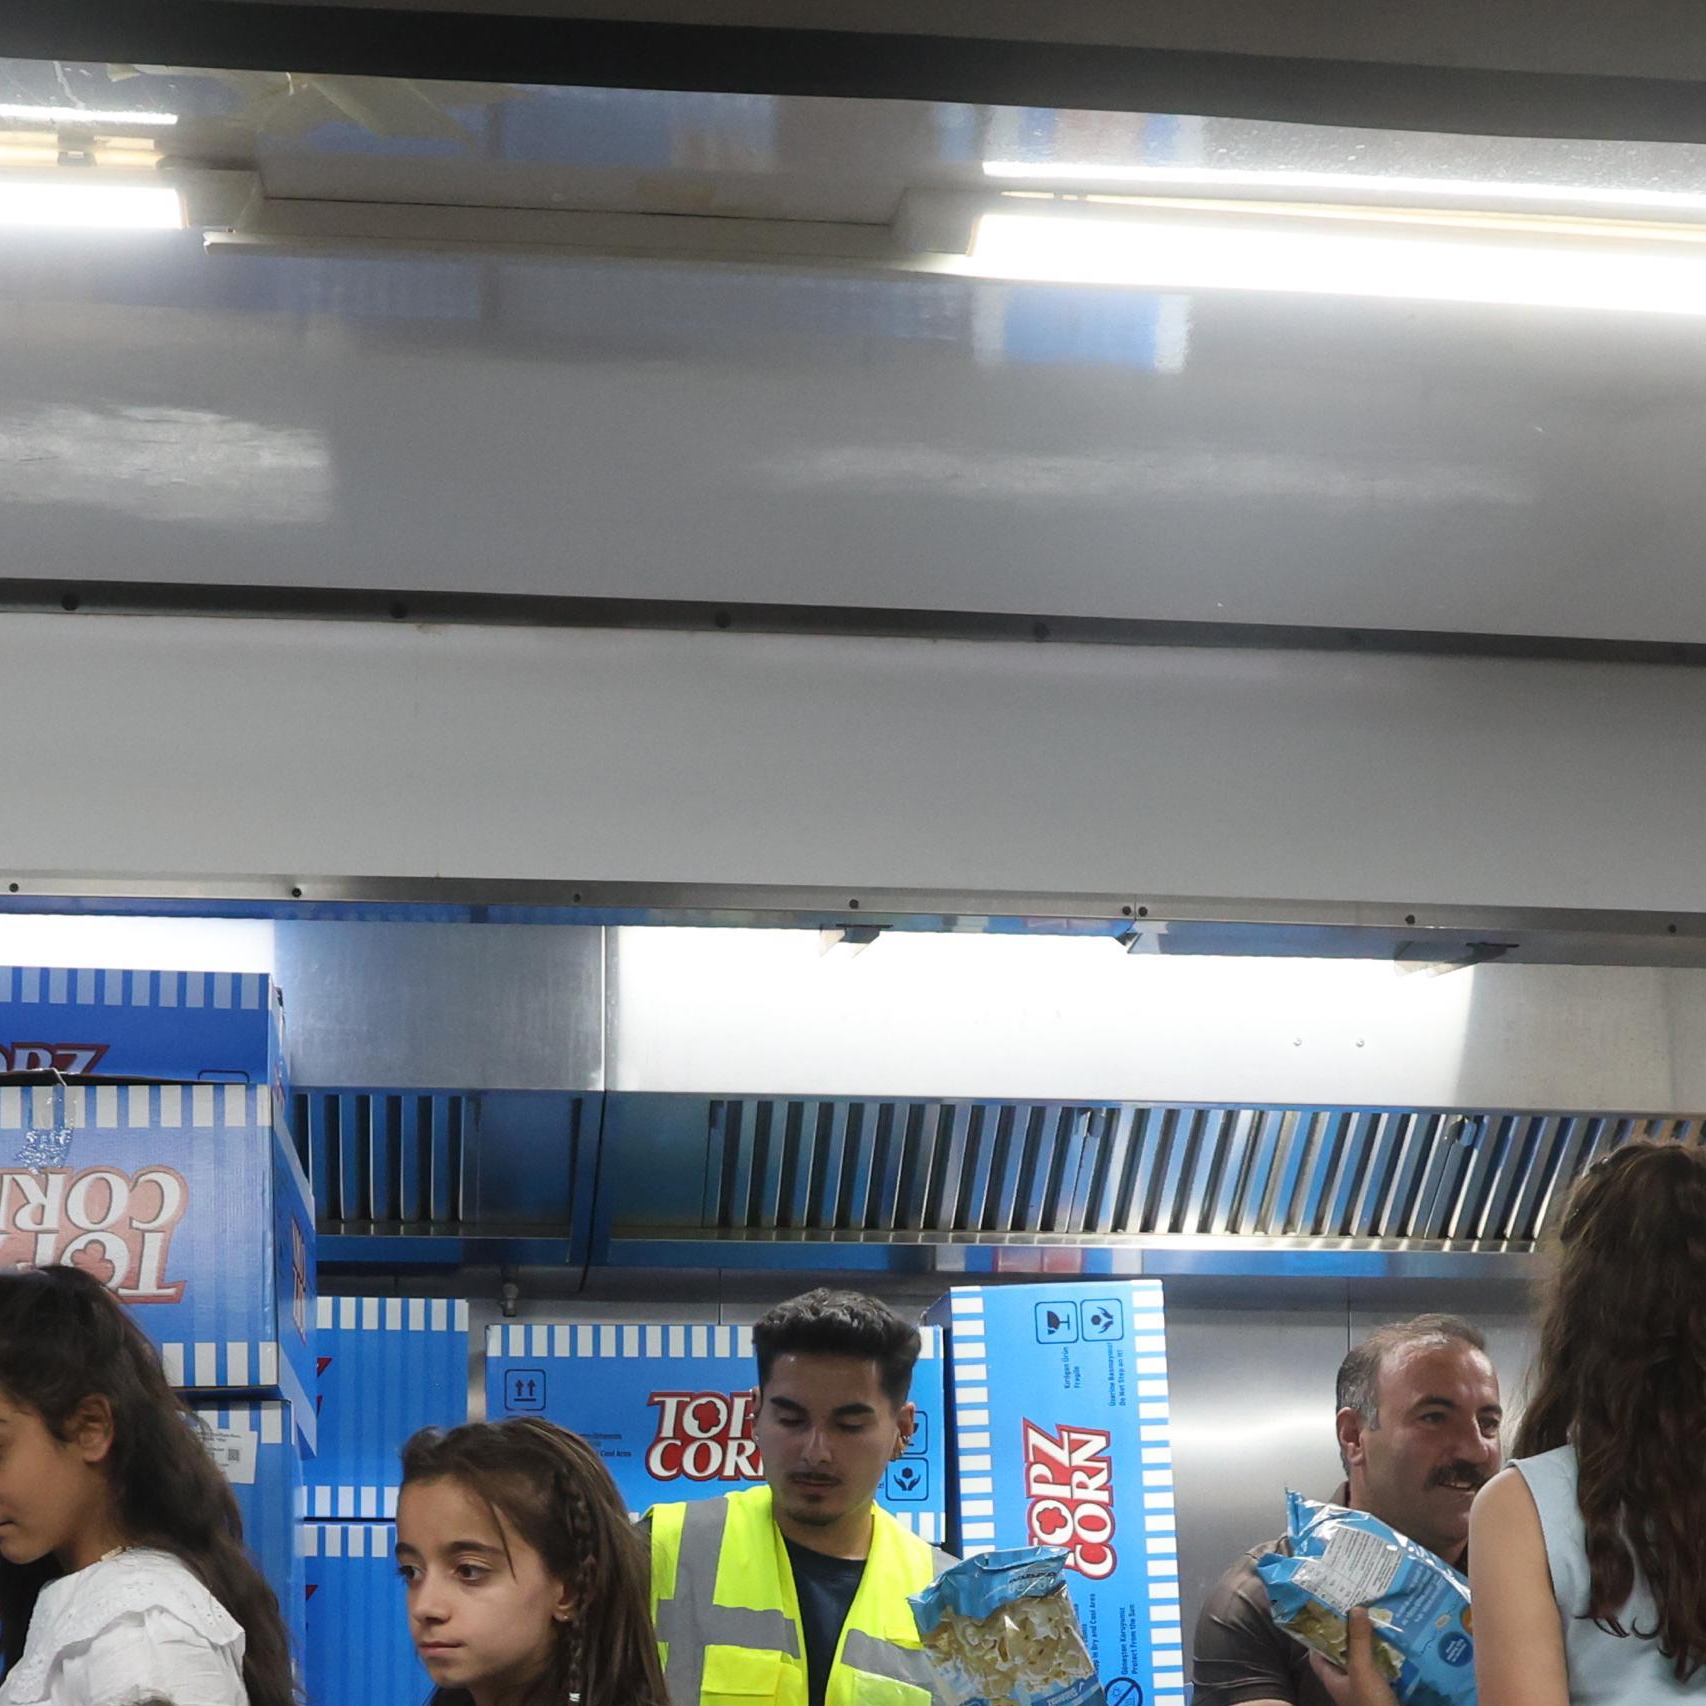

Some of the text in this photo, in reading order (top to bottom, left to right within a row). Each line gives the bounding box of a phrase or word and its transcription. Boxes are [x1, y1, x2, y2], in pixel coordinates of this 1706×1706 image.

[648, 1438, 764, 1478] COR
[1026, 1424, 1075, 1555] OPZ
[1069, 1430, 1115, 1578] CORN
